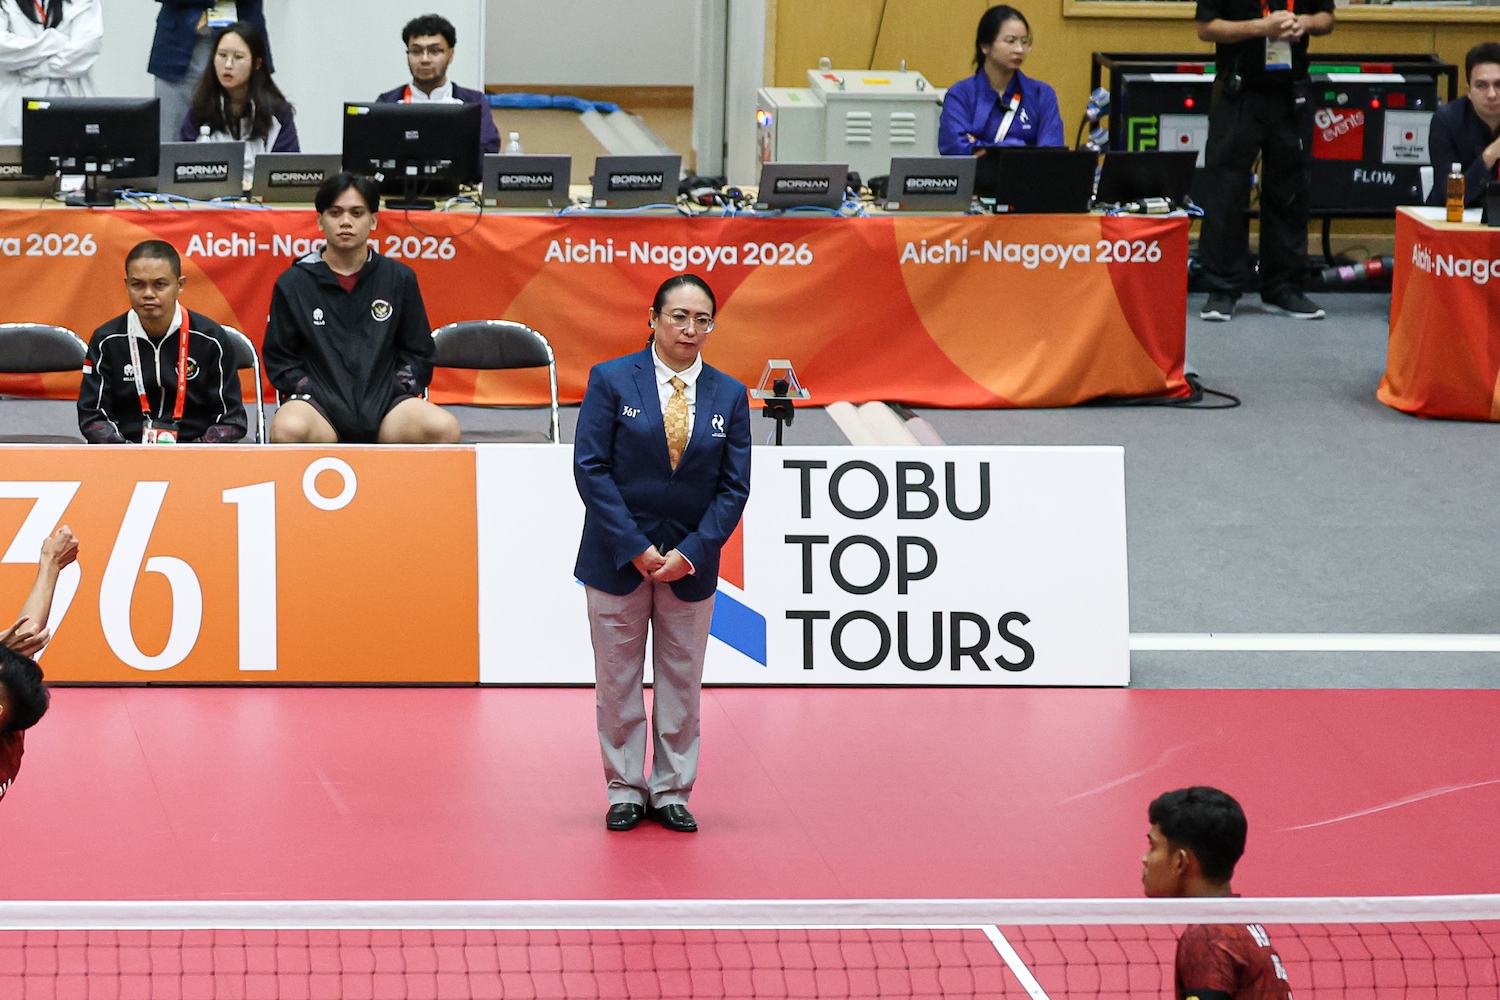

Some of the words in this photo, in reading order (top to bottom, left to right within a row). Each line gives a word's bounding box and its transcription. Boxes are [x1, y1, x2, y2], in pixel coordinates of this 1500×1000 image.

[1314, 107, 1344, 129] GL
[176, 165, 228, 175] BORNAN
[271, 173, 323, 182] BORNAN
[500, 175, 553, 184] BORNAN
[611, 175, 662, 184] BORNAN
[1353, 168, 1396, 185] FLOW
[777, 180, 828, 188] BORNAN
[906, 178, 958, 187] BORNAN
[26, 233, 97, 256] 2026
[385, 236, 456, 260] 2026
[544, 238, 738, 271] Aichi-Nagoya
[743, 242, 813, 266] 2026
[900, 239, 1090, 269] Aichi-Nagoya
[1096, 240, 1162, 263] 2026
[783, 459, 991, 521] TOBU
[784, 534, 938, 595] TOP
[786, 610, 1035, 672] TOURS
